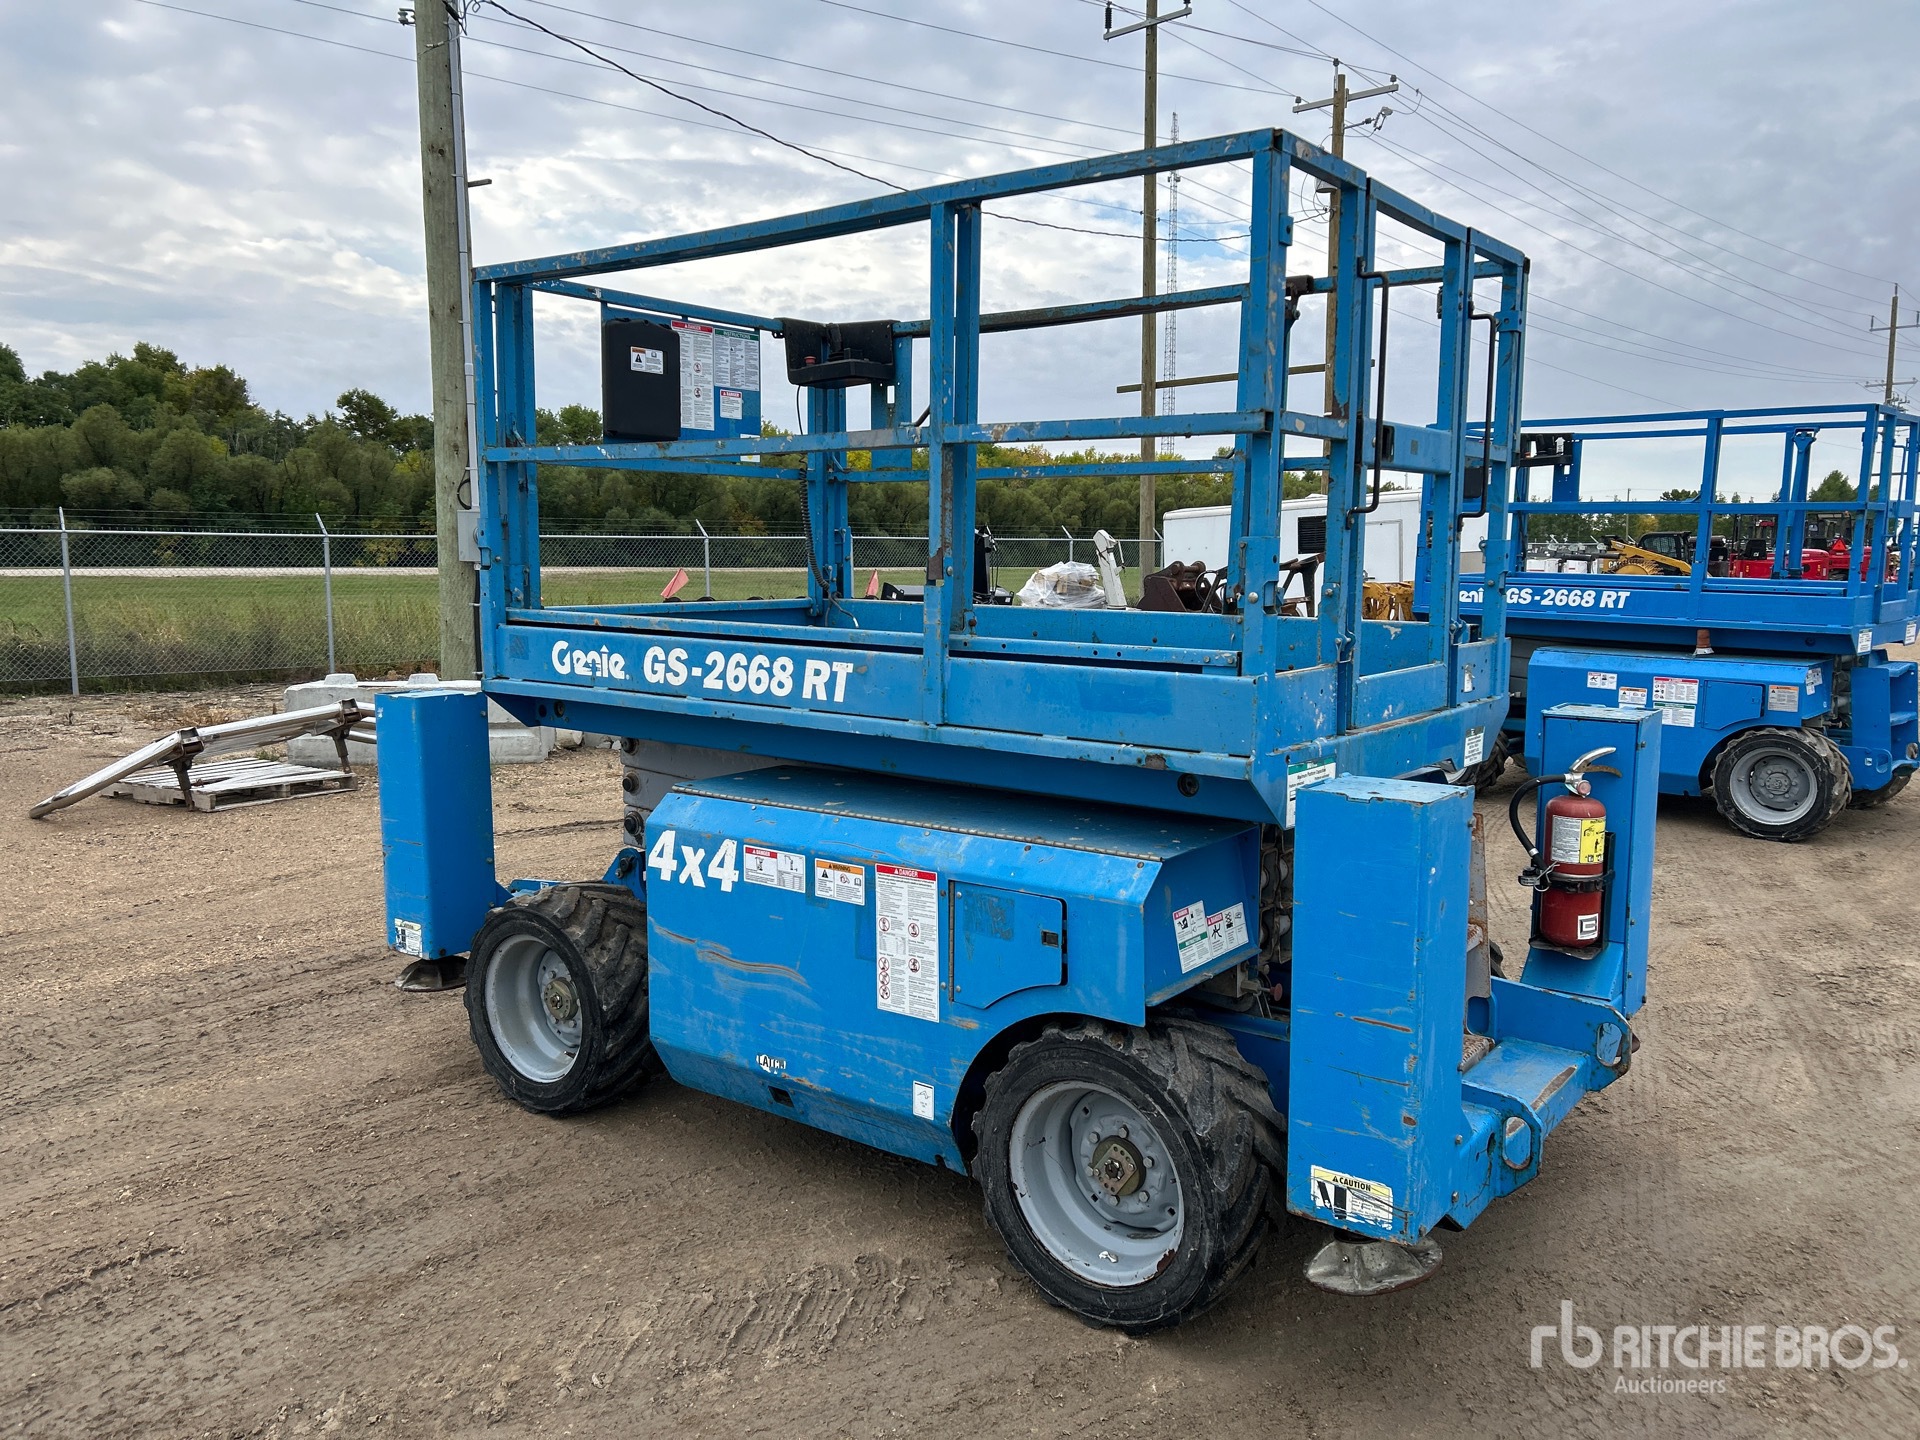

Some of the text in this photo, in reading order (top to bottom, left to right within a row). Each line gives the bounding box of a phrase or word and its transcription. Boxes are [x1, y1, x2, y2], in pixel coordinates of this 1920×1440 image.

[1507, 588, 1595, 607] GS-2668
[1599, 591, 1631, 609] RT
[551, 640, 854, 703] Genie GS-2668 RT
[648, 829, 740, 893] 4x4
[898, 869, 919, 878] DANGER
[1339, 1176, 1372, 1192] CAUTION
